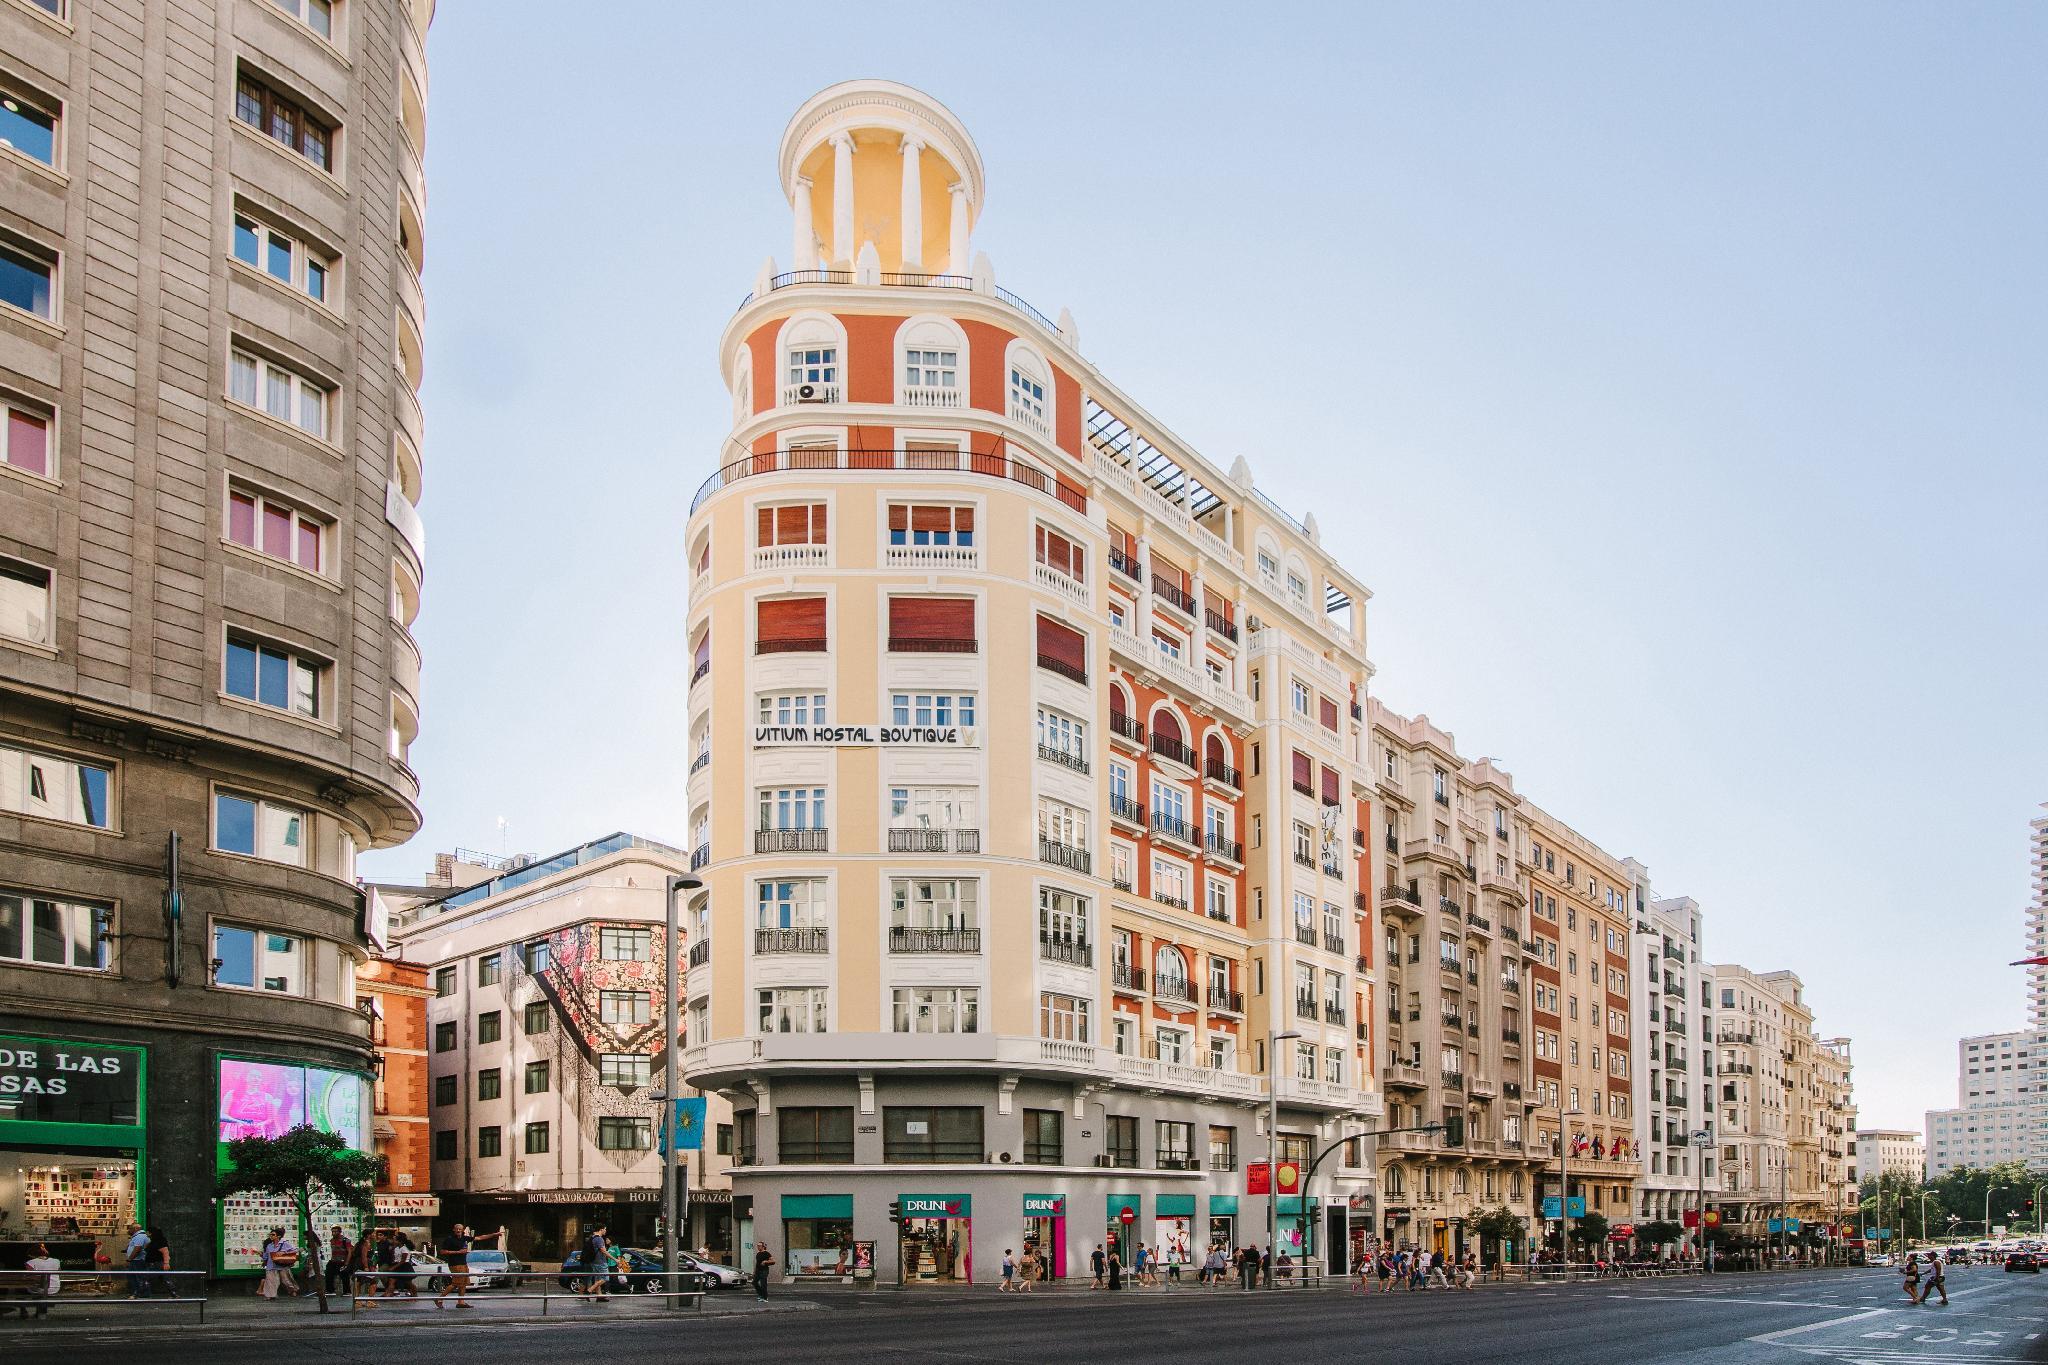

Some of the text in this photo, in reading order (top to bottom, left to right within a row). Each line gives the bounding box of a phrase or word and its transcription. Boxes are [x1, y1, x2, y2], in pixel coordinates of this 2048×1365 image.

[756, 728, 957, 742] VITIUM HOSTAL BOUTIQUE
[0, 1049, 121, 1074] DE LAS
[527, 1192, 604, 1203] HOTEL MAYORAZGO
[629, 1192, 733, 1203] HOTE YORAZGO
[907, 1201, 947, 1211] DRUNI
[1025, 1200, 1054, 1210] DRUNI
